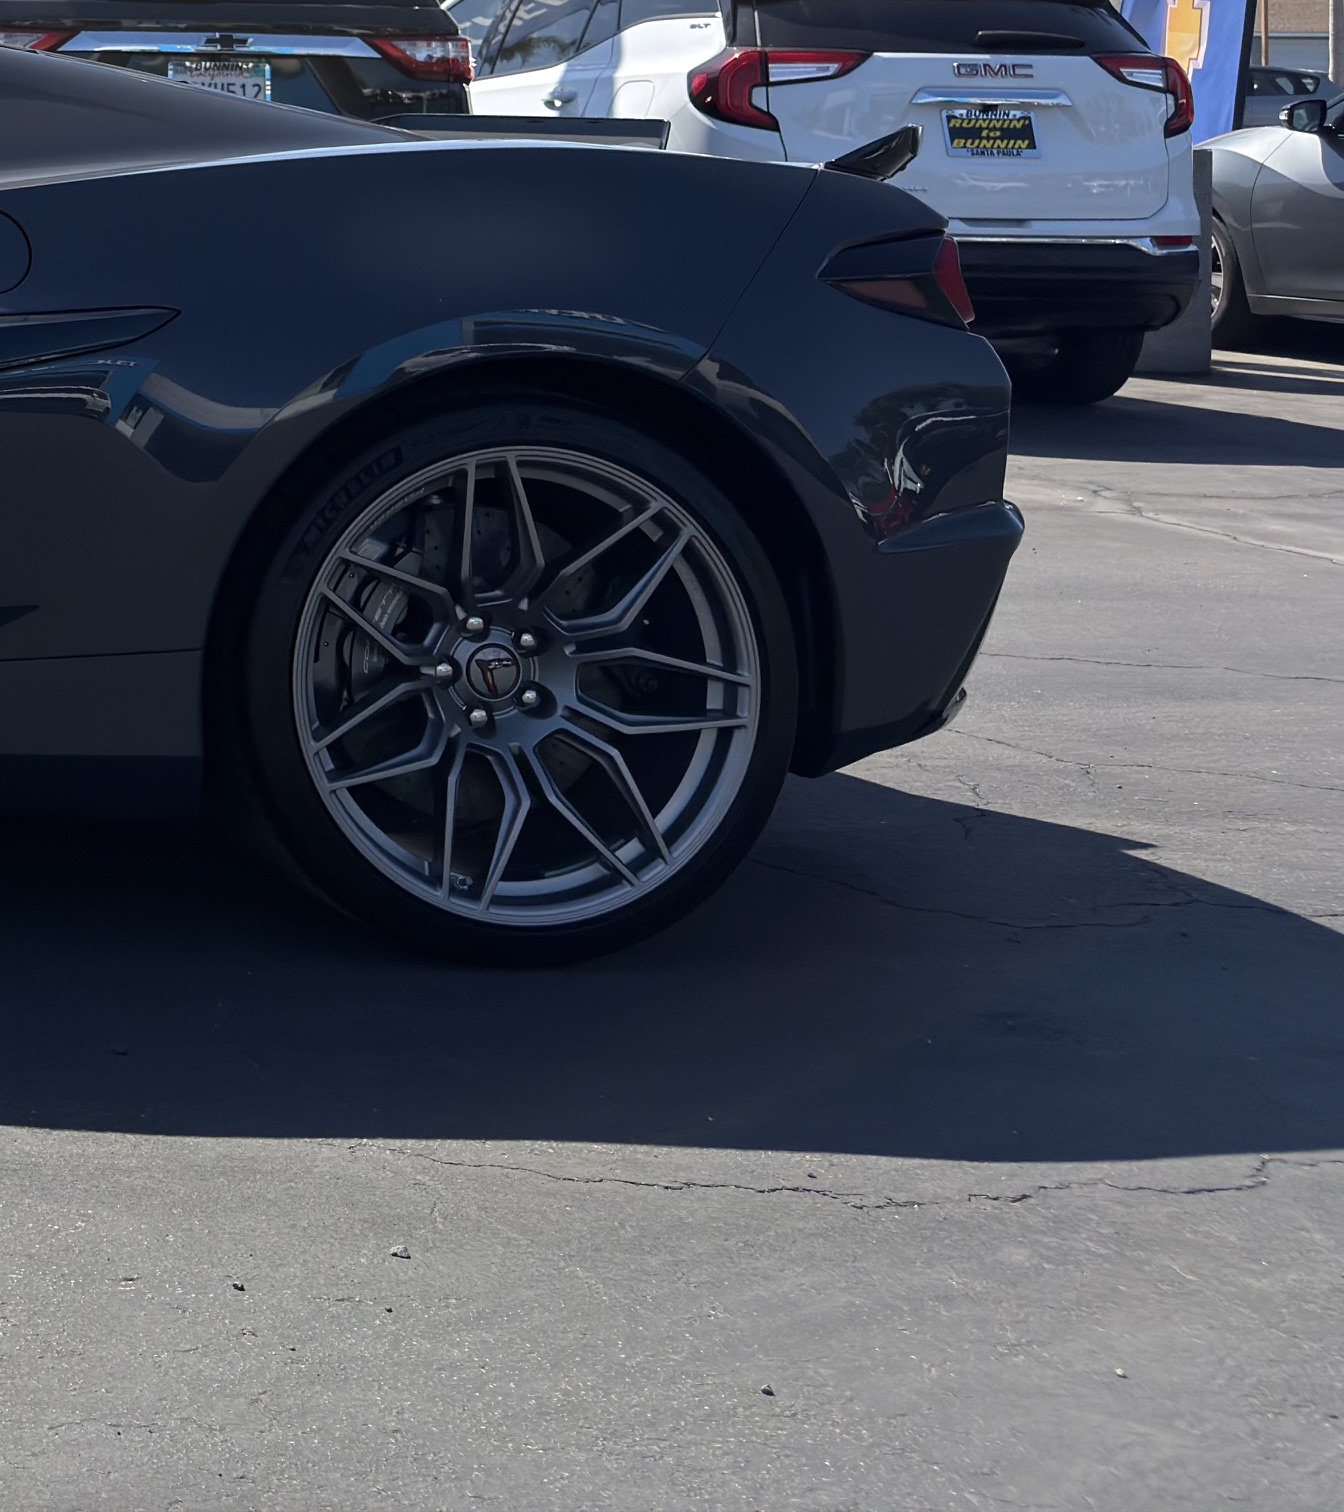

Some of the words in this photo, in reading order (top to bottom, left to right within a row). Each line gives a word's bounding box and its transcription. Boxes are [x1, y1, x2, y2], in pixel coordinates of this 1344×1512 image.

[953, 62, 1034, 78] GMC
[965, 109, 1011, 118] BUNNIN
[980, 129, 1001, 137] to
[951, 138, 1030, 149] BUNNIN
